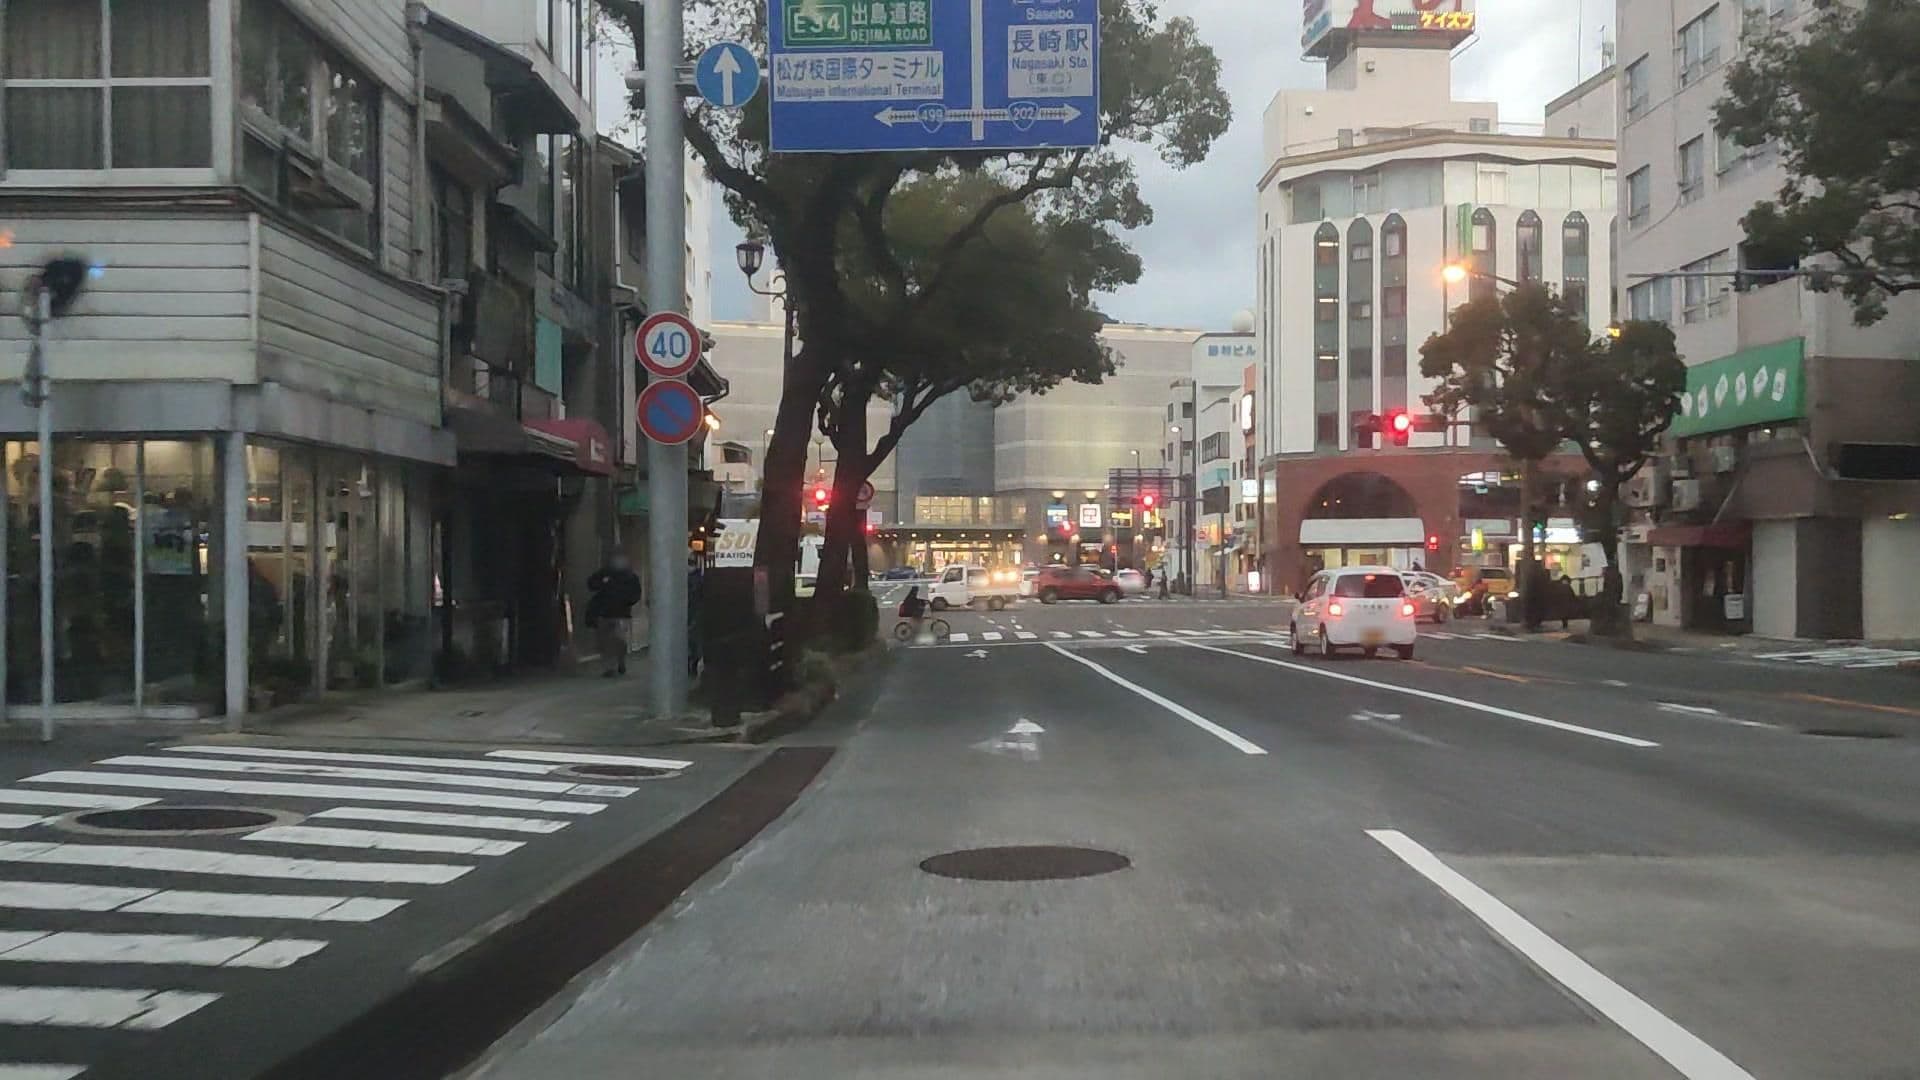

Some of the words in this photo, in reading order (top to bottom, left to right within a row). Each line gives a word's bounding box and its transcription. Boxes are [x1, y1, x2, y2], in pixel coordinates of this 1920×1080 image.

[852, 1, 927, 25] 出島道路
[793, 12, 841, 33] E34
[852, 29, 891, 43] DEJIMA
[896, 28, 928, 41] ROAD
[1013, 29, 1089, 53] 長崎駅
[1012, 56, 1065, 70] Nagasaki
[896, 83, 940, 96] Terminal
[922, 108, 944, 122] 499
[1013, 106, 1034, 119] 202
[652, 331, 686, 358] 40
